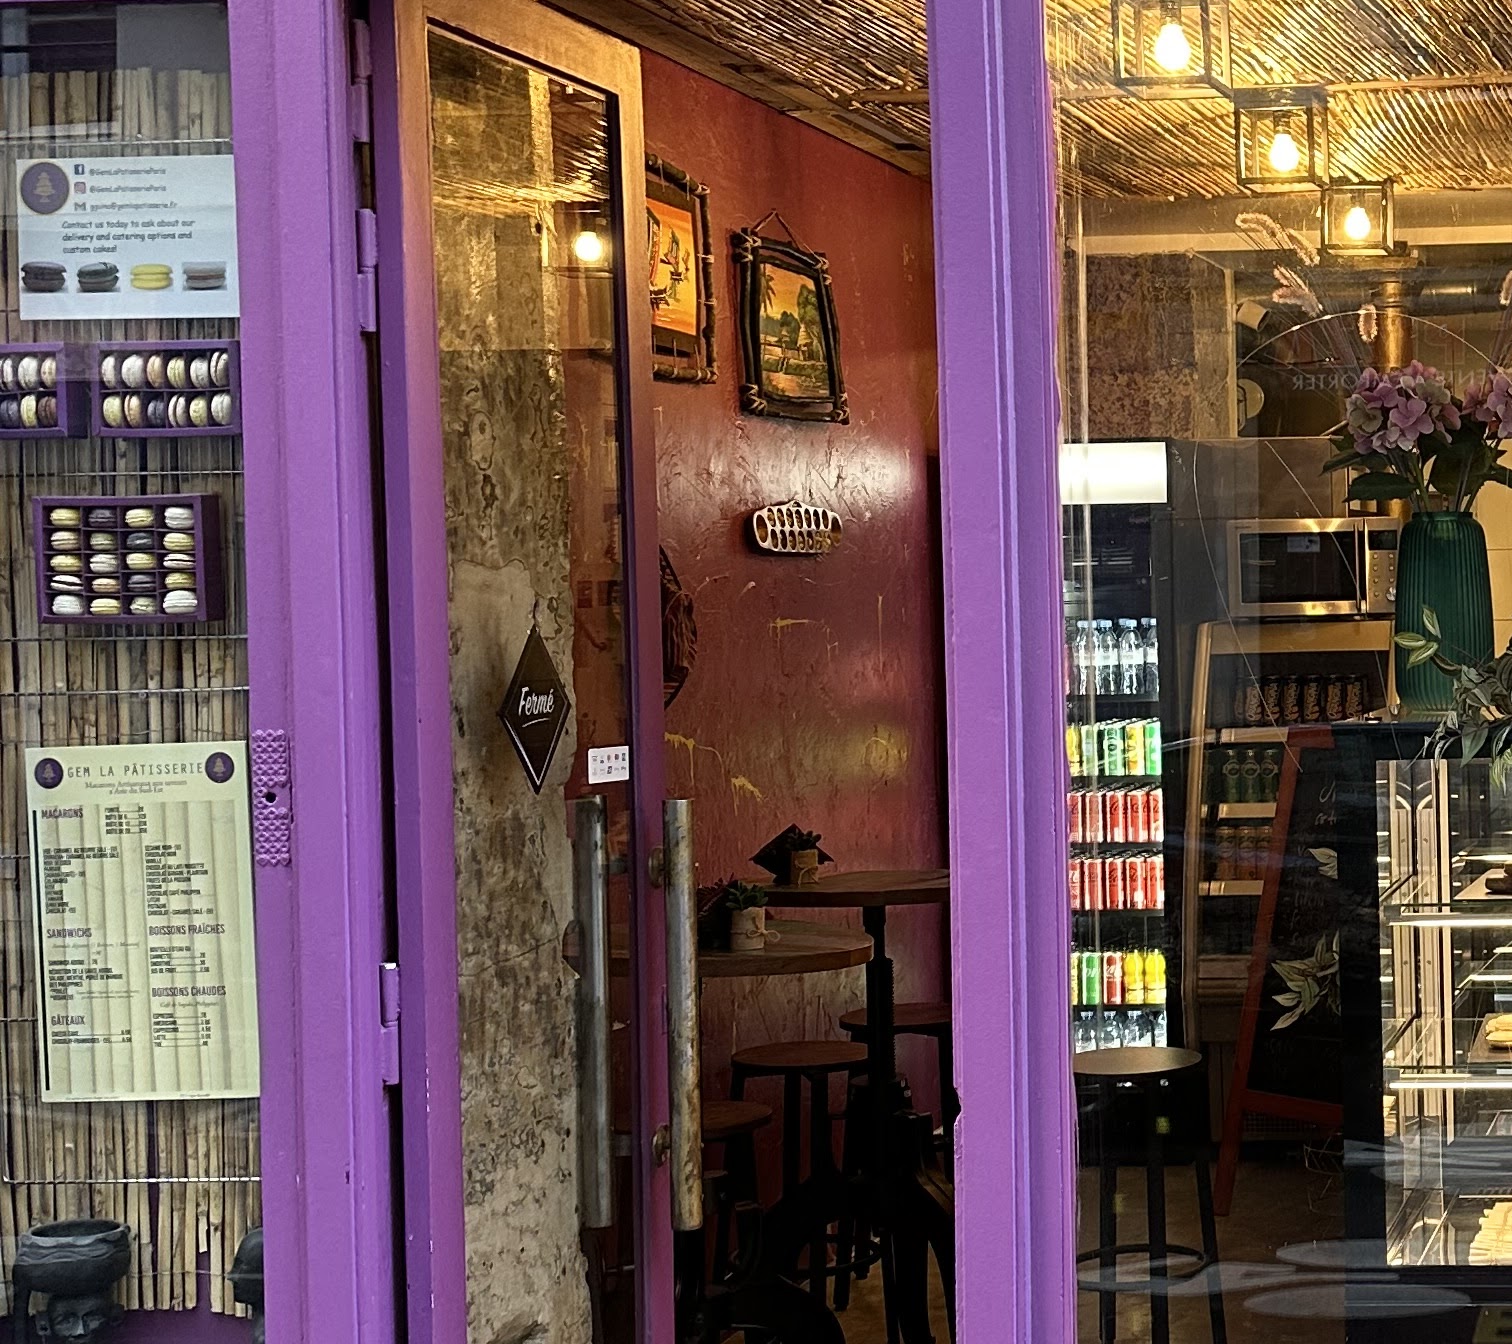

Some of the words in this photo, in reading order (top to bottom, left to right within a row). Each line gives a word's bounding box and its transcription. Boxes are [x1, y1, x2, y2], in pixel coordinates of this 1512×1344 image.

[61, 220, 92, 229] Contact
[106, 220, 128, 229] today
[157, 219, 179, 227] about
[181, 219, 196, 227] our
[62, 233, 93, 242] delivery
[96, 232, 110, 240] and
[112, 231, 145, 242] catering
[177, 231, 193, 239] and
[518, 687, 555, 716] Fermé
[67, 766, 90, 778] GEM
[100, 765, 115, 777] LA
[124, 762, 204, 776] PÂTISSERIE
[41, 807, 83, 819] MACARONS
[148, 925, 186, 936] BOISSONS
[151, 987, 189, 998] BOISSONS
[190, 985, 226, 997] CHAUDES
[51, 1013, 86, 1026] GÂTEAUX
